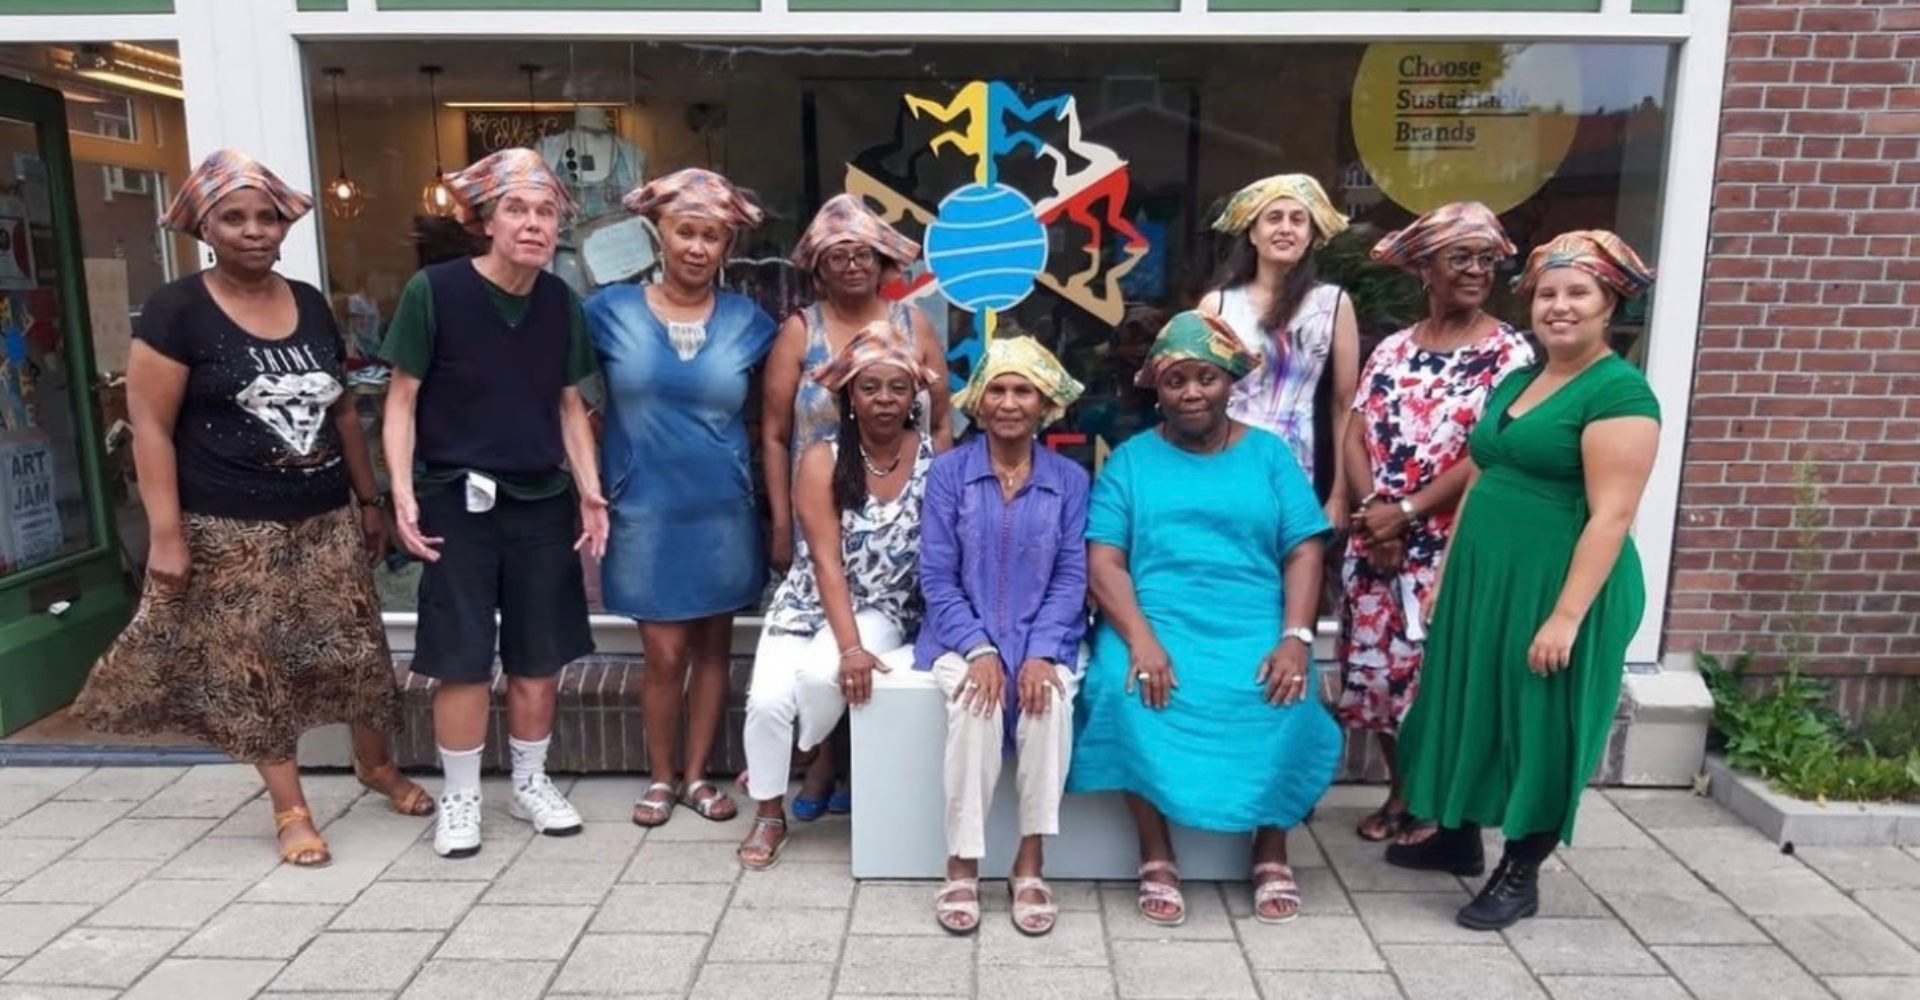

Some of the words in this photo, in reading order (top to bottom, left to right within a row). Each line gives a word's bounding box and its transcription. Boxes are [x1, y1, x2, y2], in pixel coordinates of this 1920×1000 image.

[1398, 55, 1482, 78] Choose
[1396, 88, 1531, 110] Sustainable
[1394, 121, 1476, 143] Brands
[247, 344, 322, 372] SHINE
[12, 450, 46, 479] ART
[14, 482, 50, 511] JAM
